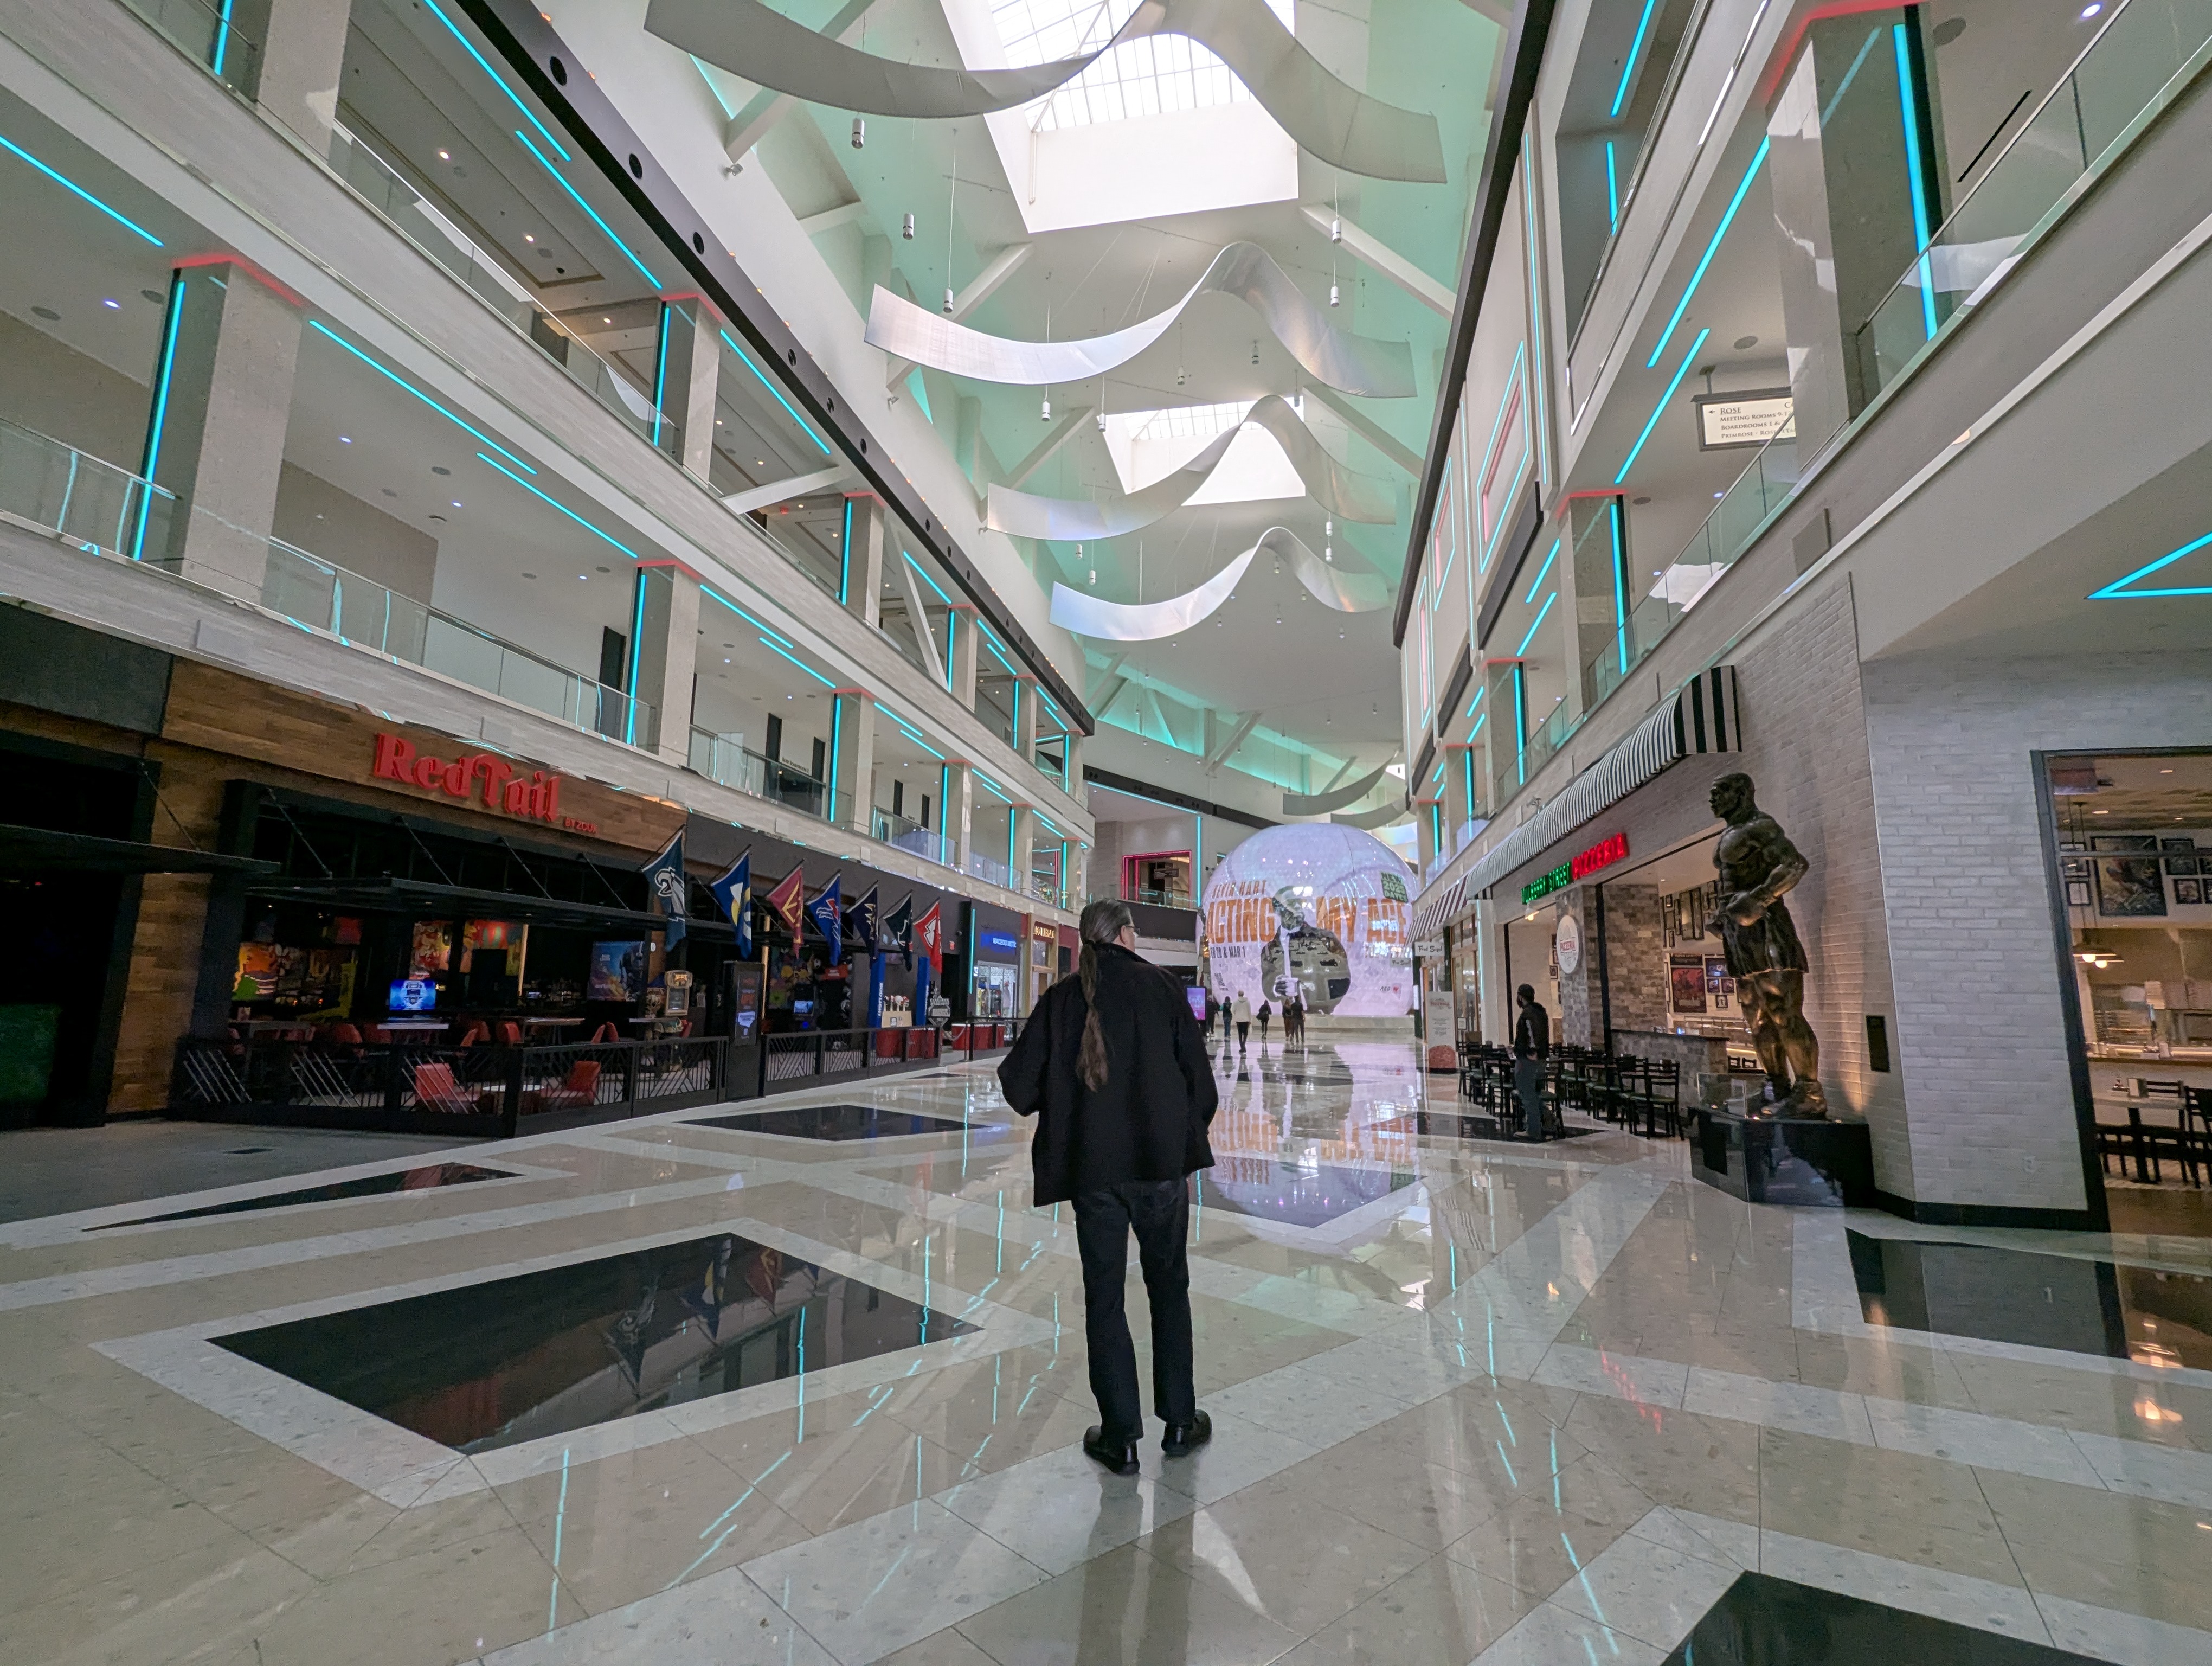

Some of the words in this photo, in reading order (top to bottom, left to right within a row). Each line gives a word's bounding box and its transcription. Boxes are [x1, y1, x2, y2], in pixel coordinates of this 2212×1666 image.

[1721, 422, 1767, 430] BOARDROOMS
[1572, 832, 1626, 881] PIZZERIA
[1239, 880, 1267, 896] HART
[1206, 897, 1275, 944] ACTING
[1316, 896, 1357, 943] MY
[1229, 946, 1242, 958] MAR
